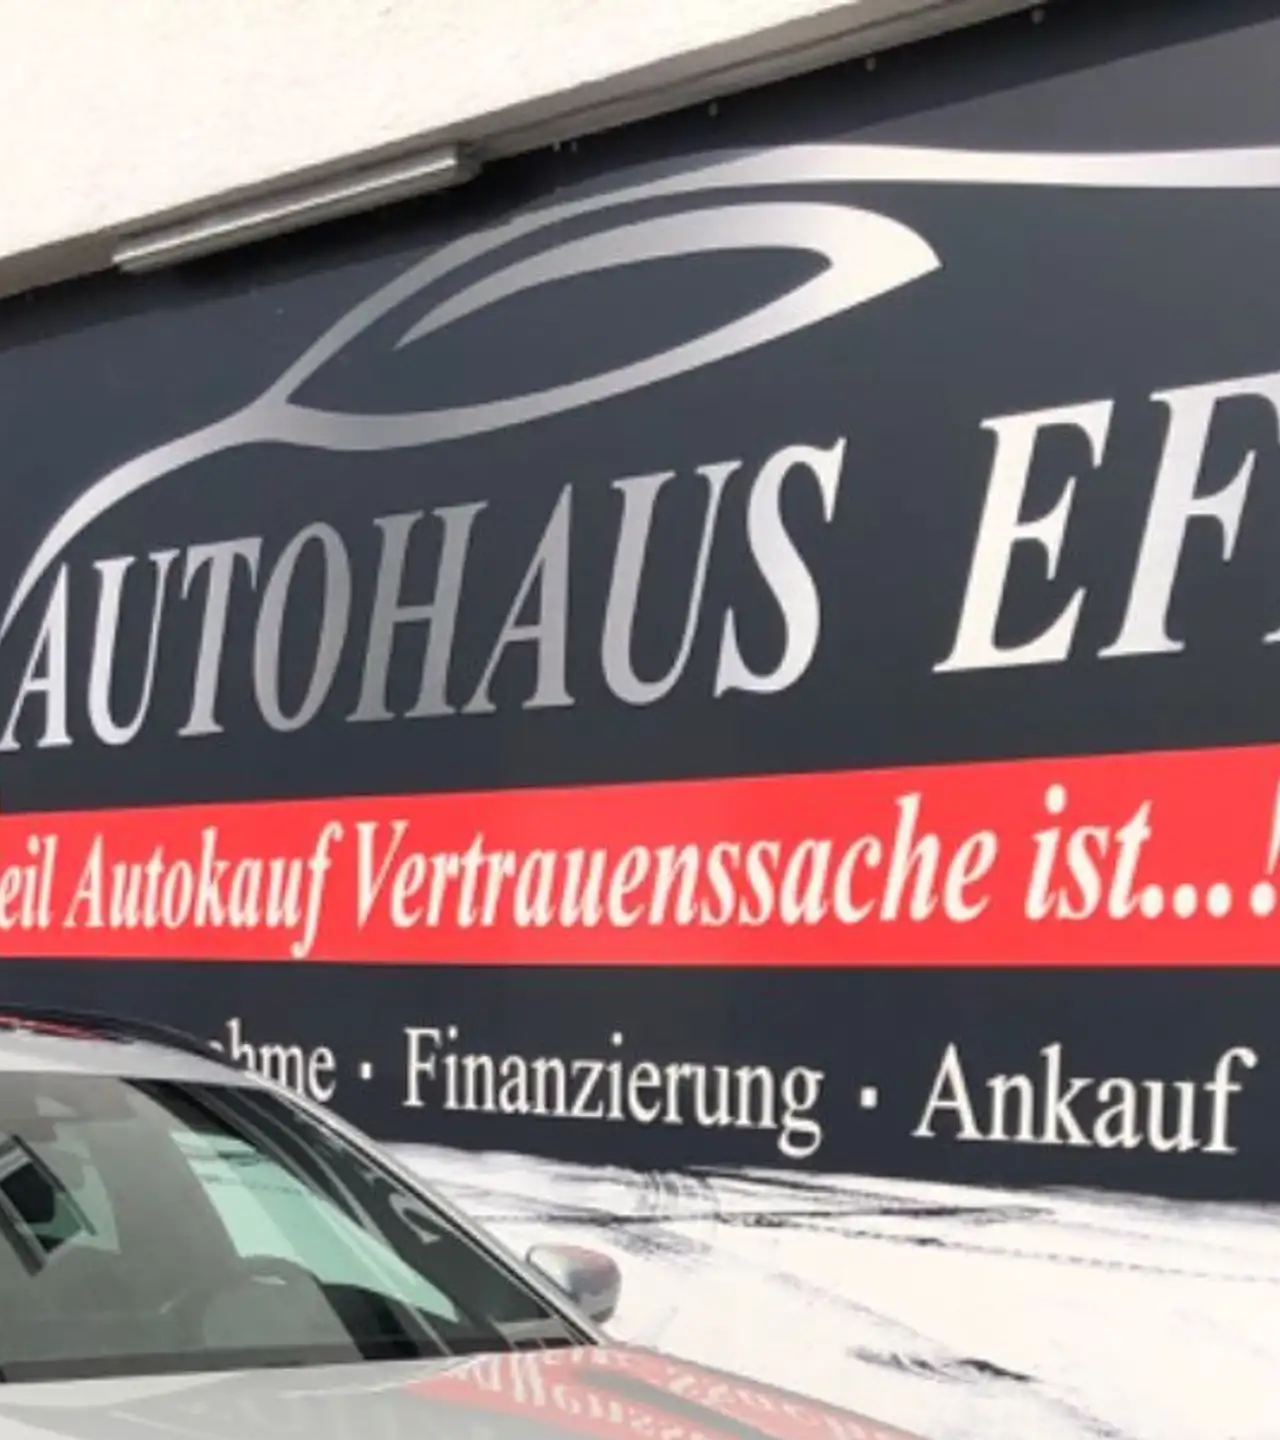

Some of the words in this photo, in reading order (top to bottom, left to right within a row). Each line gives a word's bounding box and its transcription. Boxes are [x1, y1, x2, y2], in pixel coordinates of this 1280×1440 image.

[62, 820, 345, 960] Autokauf
[354, 793, 999, 932] Vertrauenssache
[402, 1025, 825, 1159] Finanzierung
[910, 1042, 1260, 1155] Ankauf
